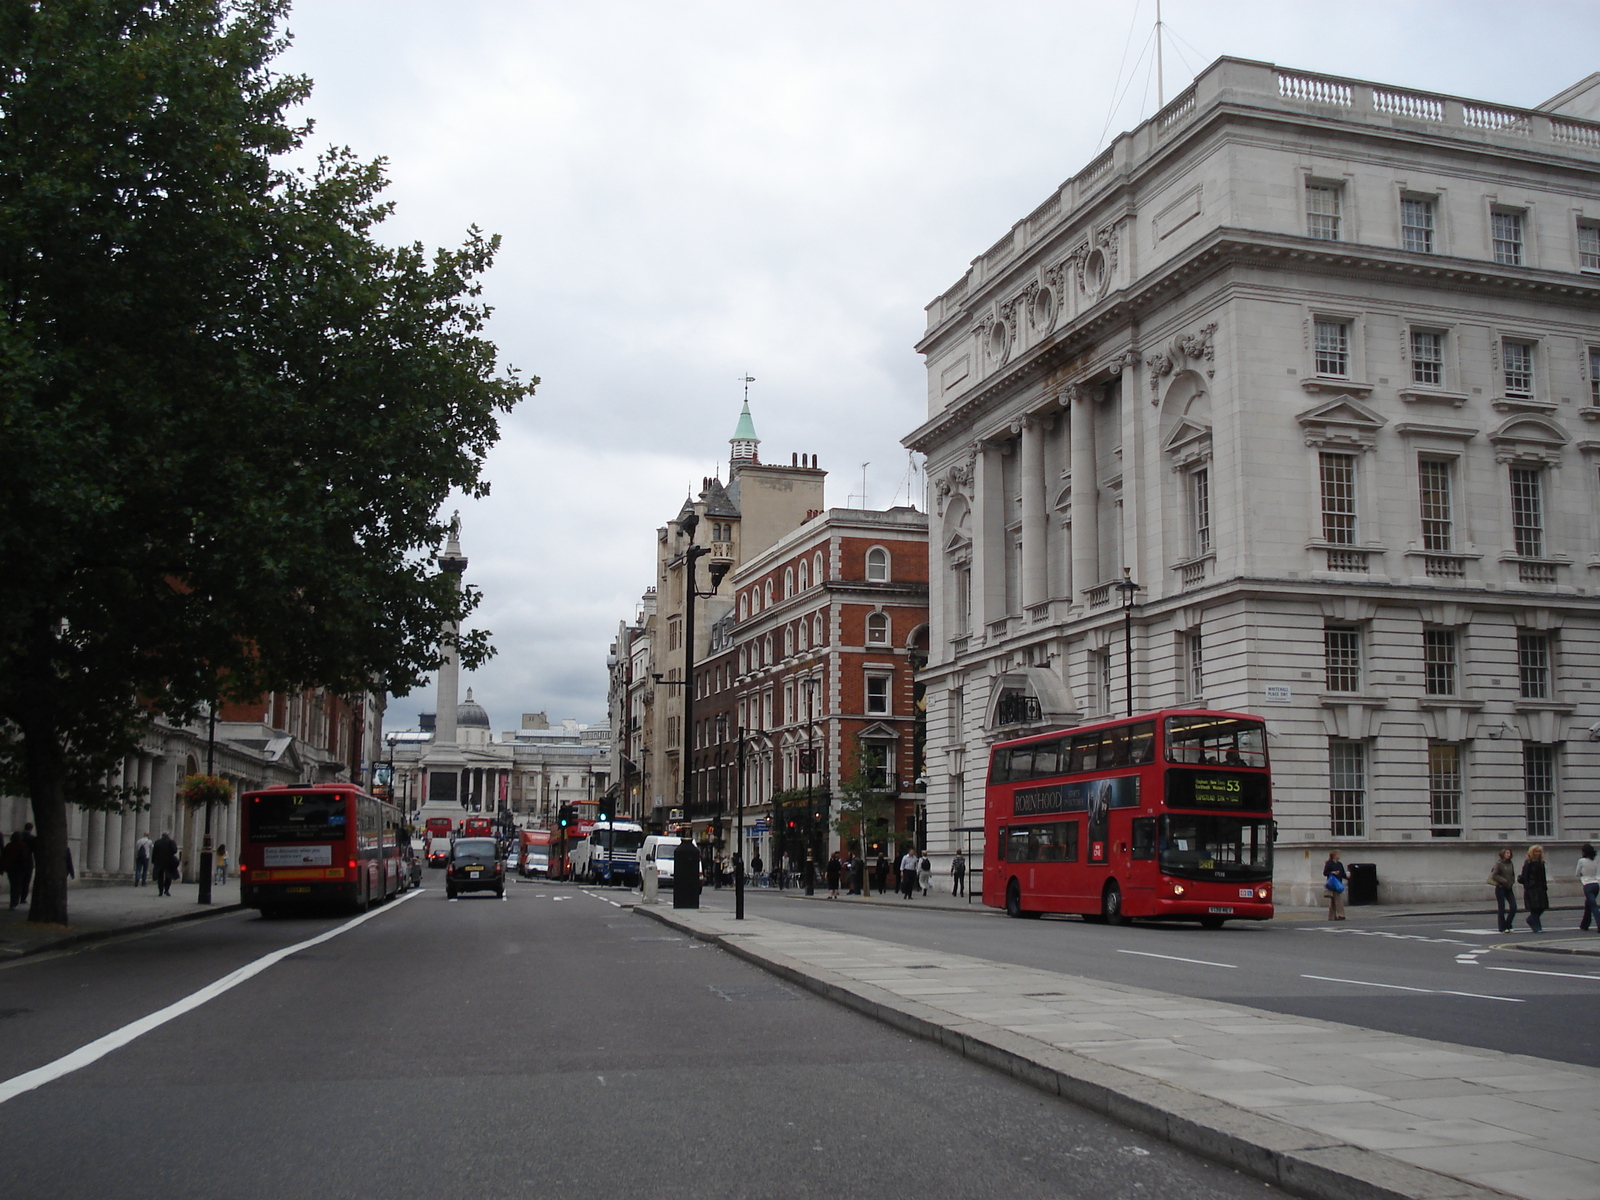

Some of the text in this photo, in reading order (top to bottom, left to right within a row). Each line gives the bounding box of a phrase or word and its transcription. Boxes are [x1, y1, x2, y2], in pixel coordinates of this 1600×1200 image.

[1226, 780, 1241, 792] 53
[292, 795, 303, 805] 12
[1015, 794, 1037, 812] ROBIN
[1037, 791, 1062, 810] HOOD
